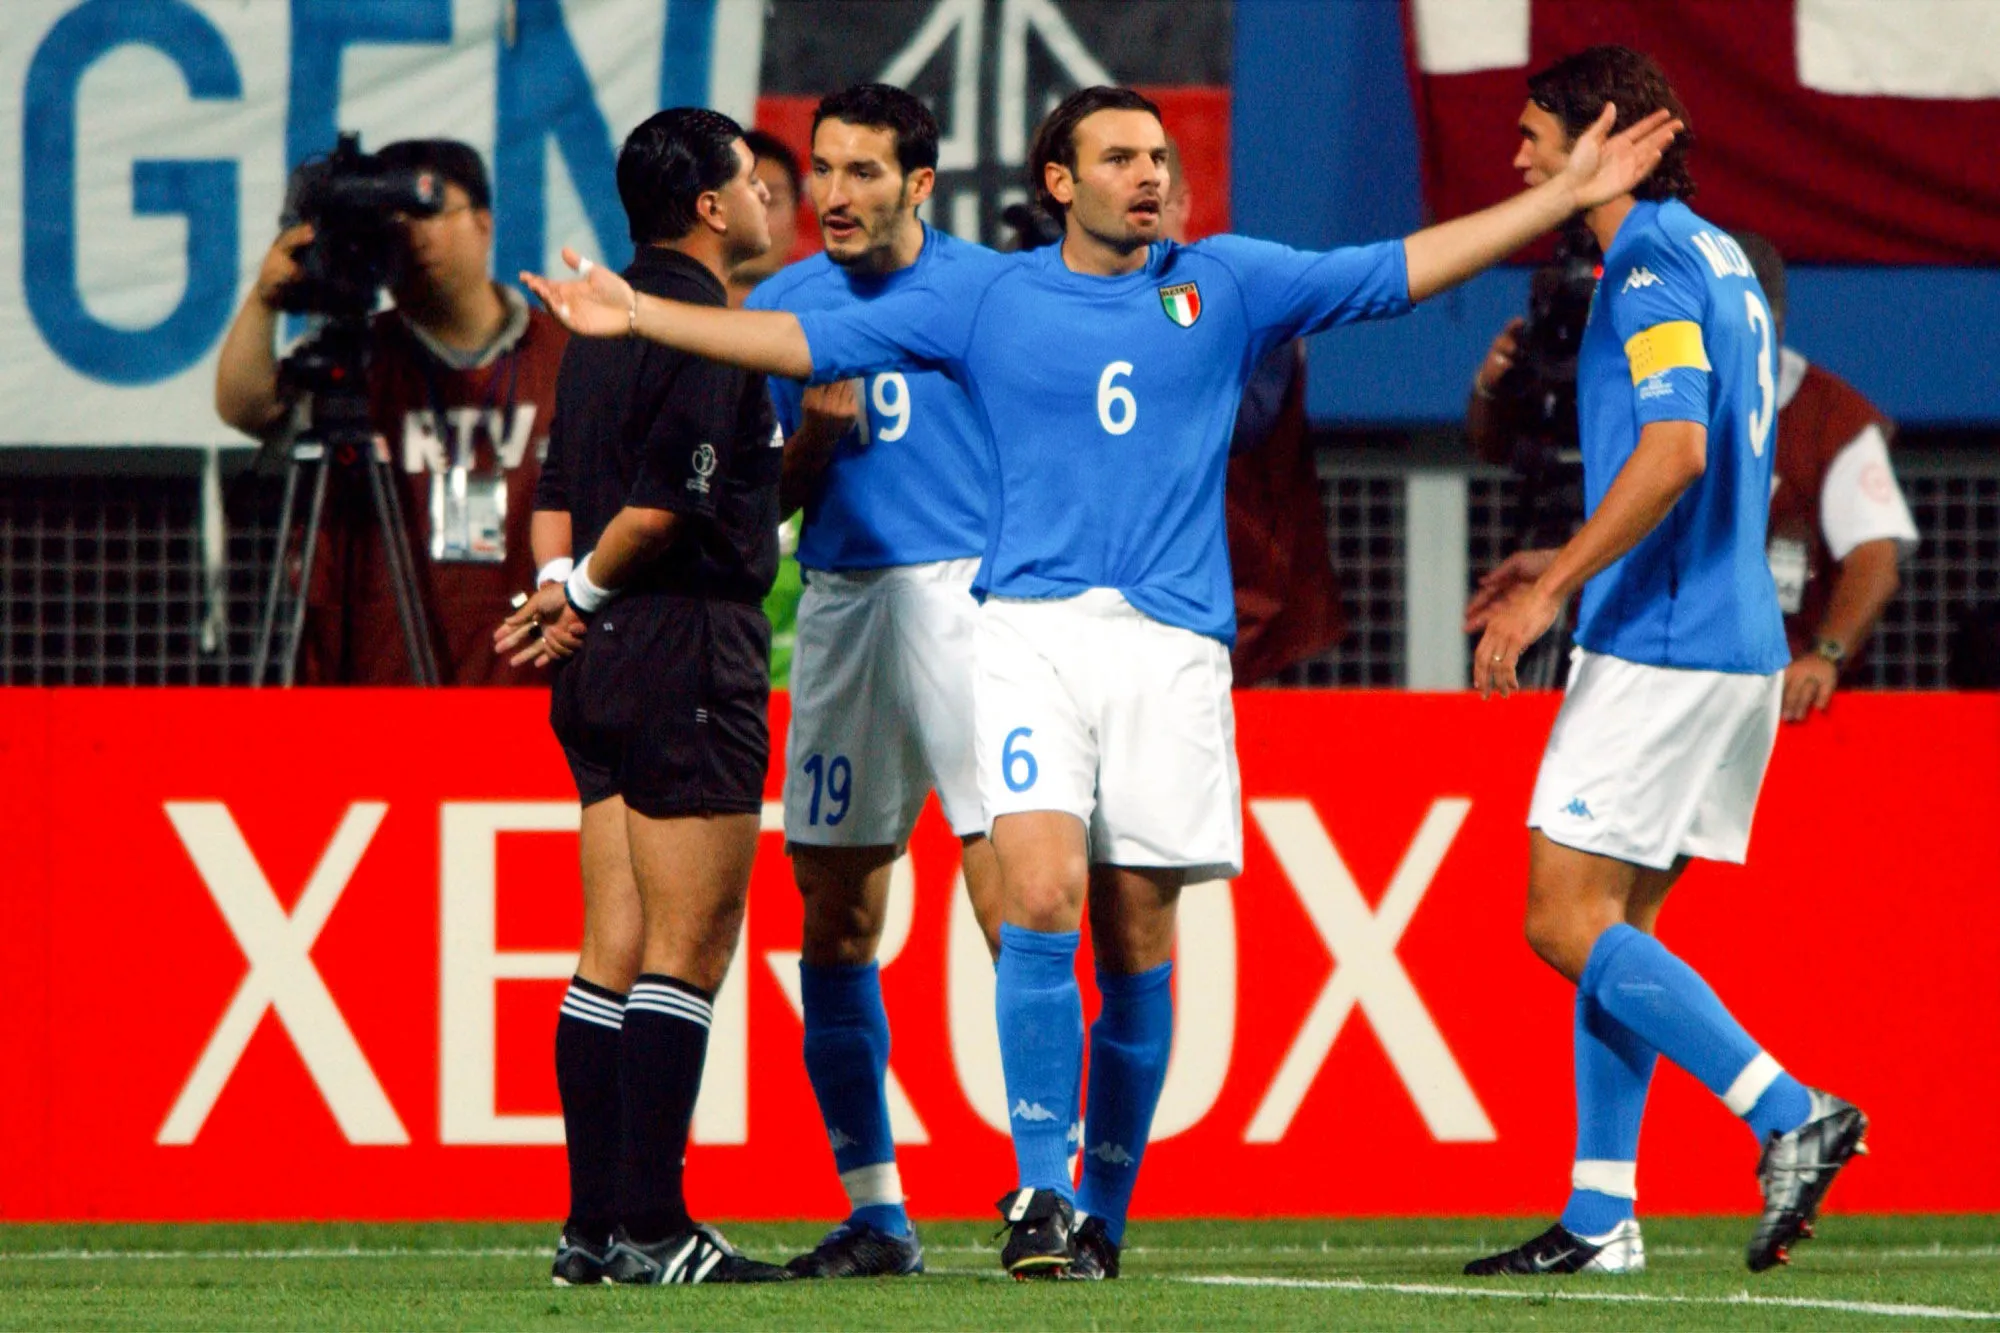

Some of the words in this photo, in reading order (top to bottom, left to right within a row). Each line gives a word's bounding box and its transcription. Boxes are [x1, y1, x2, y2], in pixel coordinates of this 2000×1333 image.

[852, 371, 911, 445] 19
[1098, 360, 1137, 436] 6
[1744, 290, 1775, 457] 3
[803, 753, 853, 826] 19
[1001, 726, 1039, 793] 6
[155, 800, 1496, 1145] XEOX
